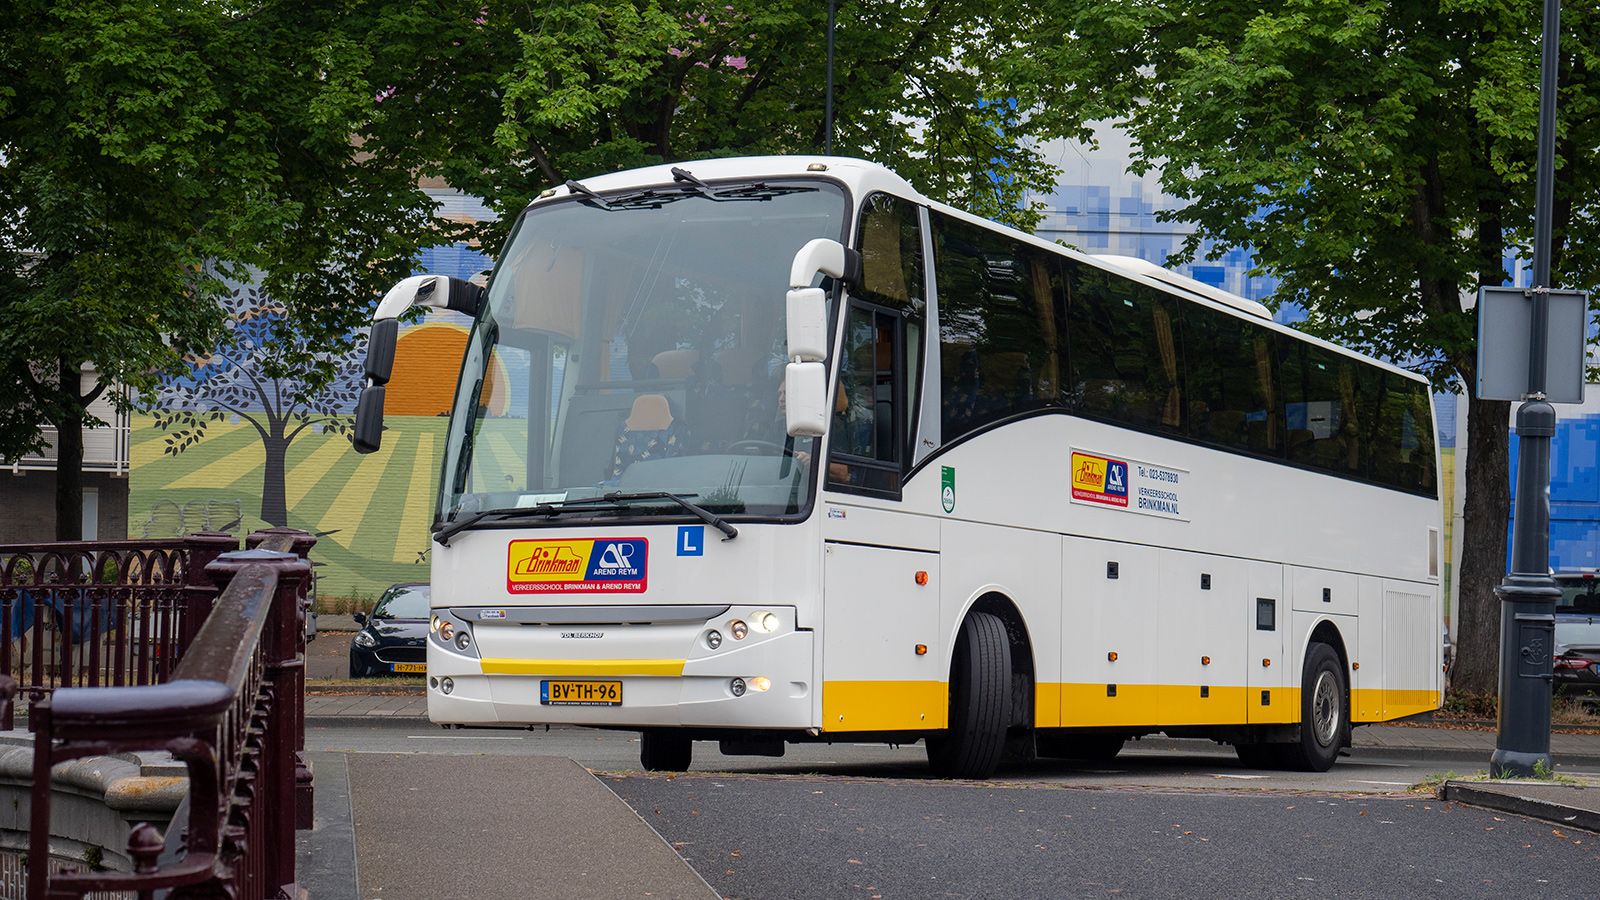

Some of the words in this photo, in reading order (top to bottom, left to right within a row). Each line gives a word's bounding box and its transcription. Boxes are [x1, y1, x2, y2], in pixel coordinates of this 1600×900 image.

[1137, 466, 1148, 478] Tel.:
[1138, 487, 1179, 502] VERKEERSSCHOOL
[1138, 497, 1180, 515] BRINKMAN.NL
[683, 531, 697, 551] L
[526, 546, 580, 573] Brinkman
[593, 568, 617, 576] AREND
[618, 568, 638, 576] REYM
[511, 583, 563, 591] VERKEERSSCHOOL
[553, 684, 617, 699] BV-TH-96
